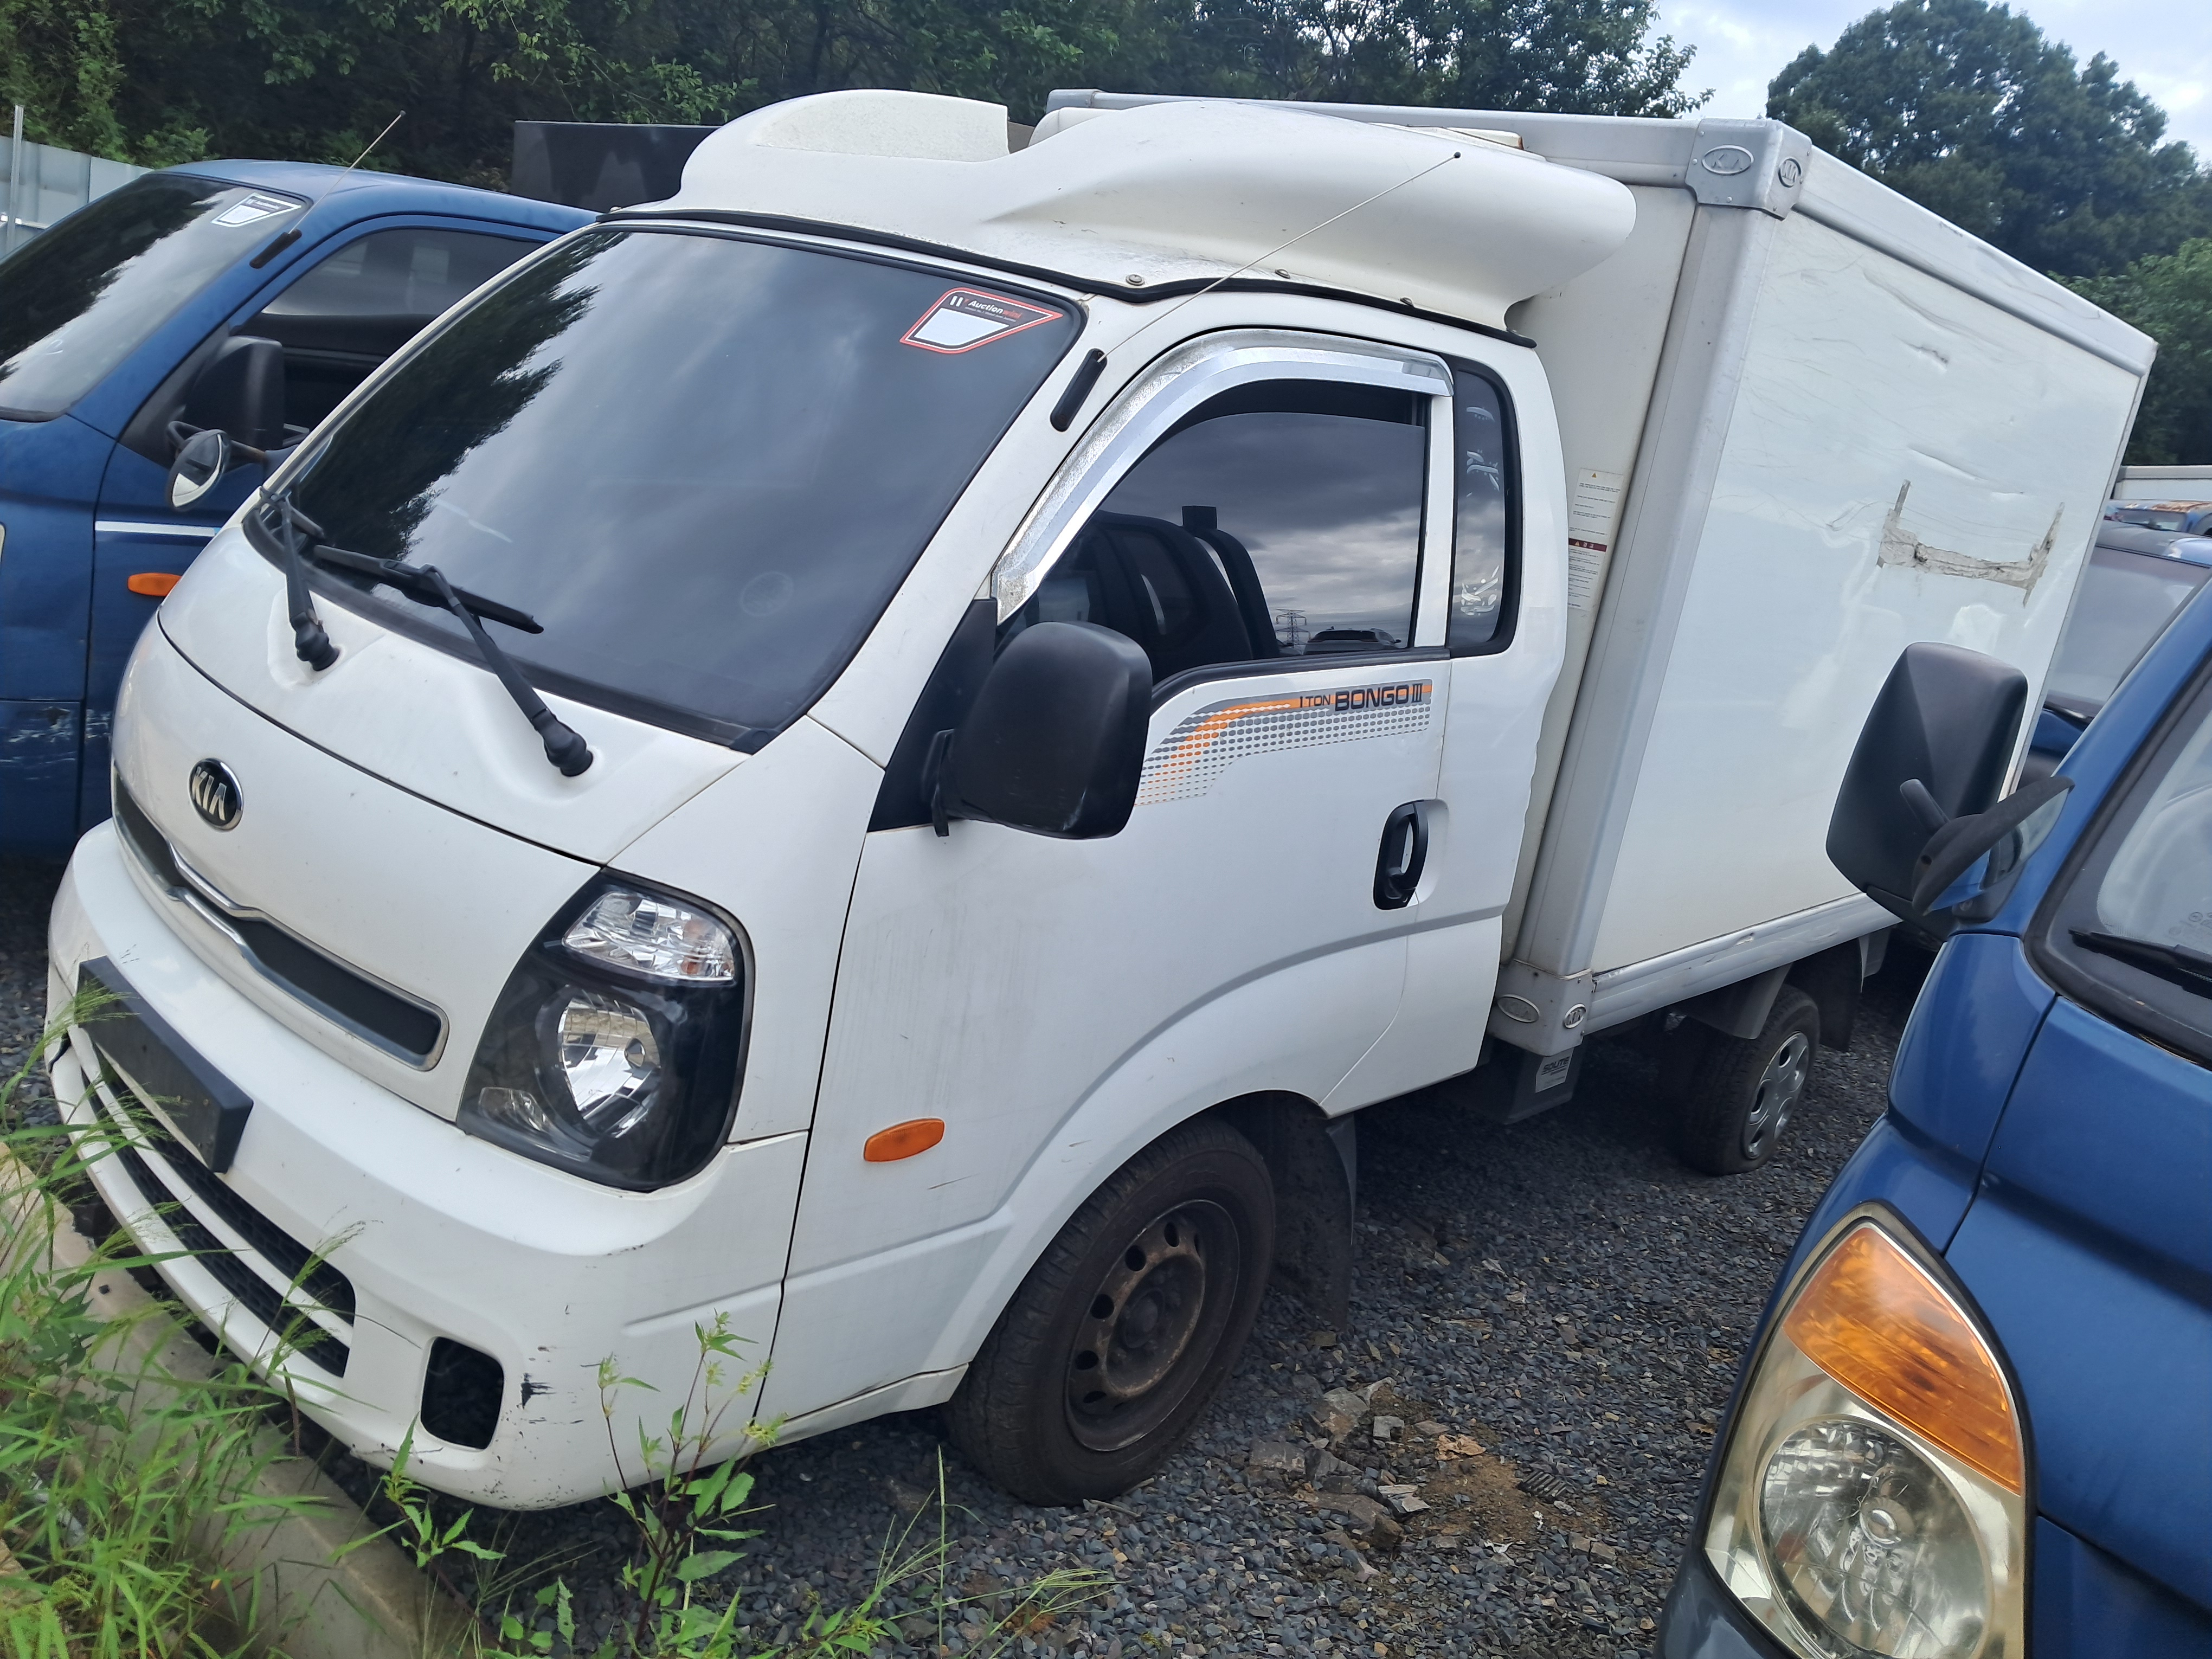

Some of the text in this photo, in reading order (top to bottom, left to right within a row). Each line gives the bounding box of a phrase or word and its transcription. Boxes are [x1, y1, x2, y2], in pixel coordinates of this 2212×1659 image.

[1306, 694, 1331, 708] TON
[1335, 684, 1410, 711] BONGO
[191, 766, 227, 821] KIA
[1542, 1056, 1570, 1072] SOLITE
